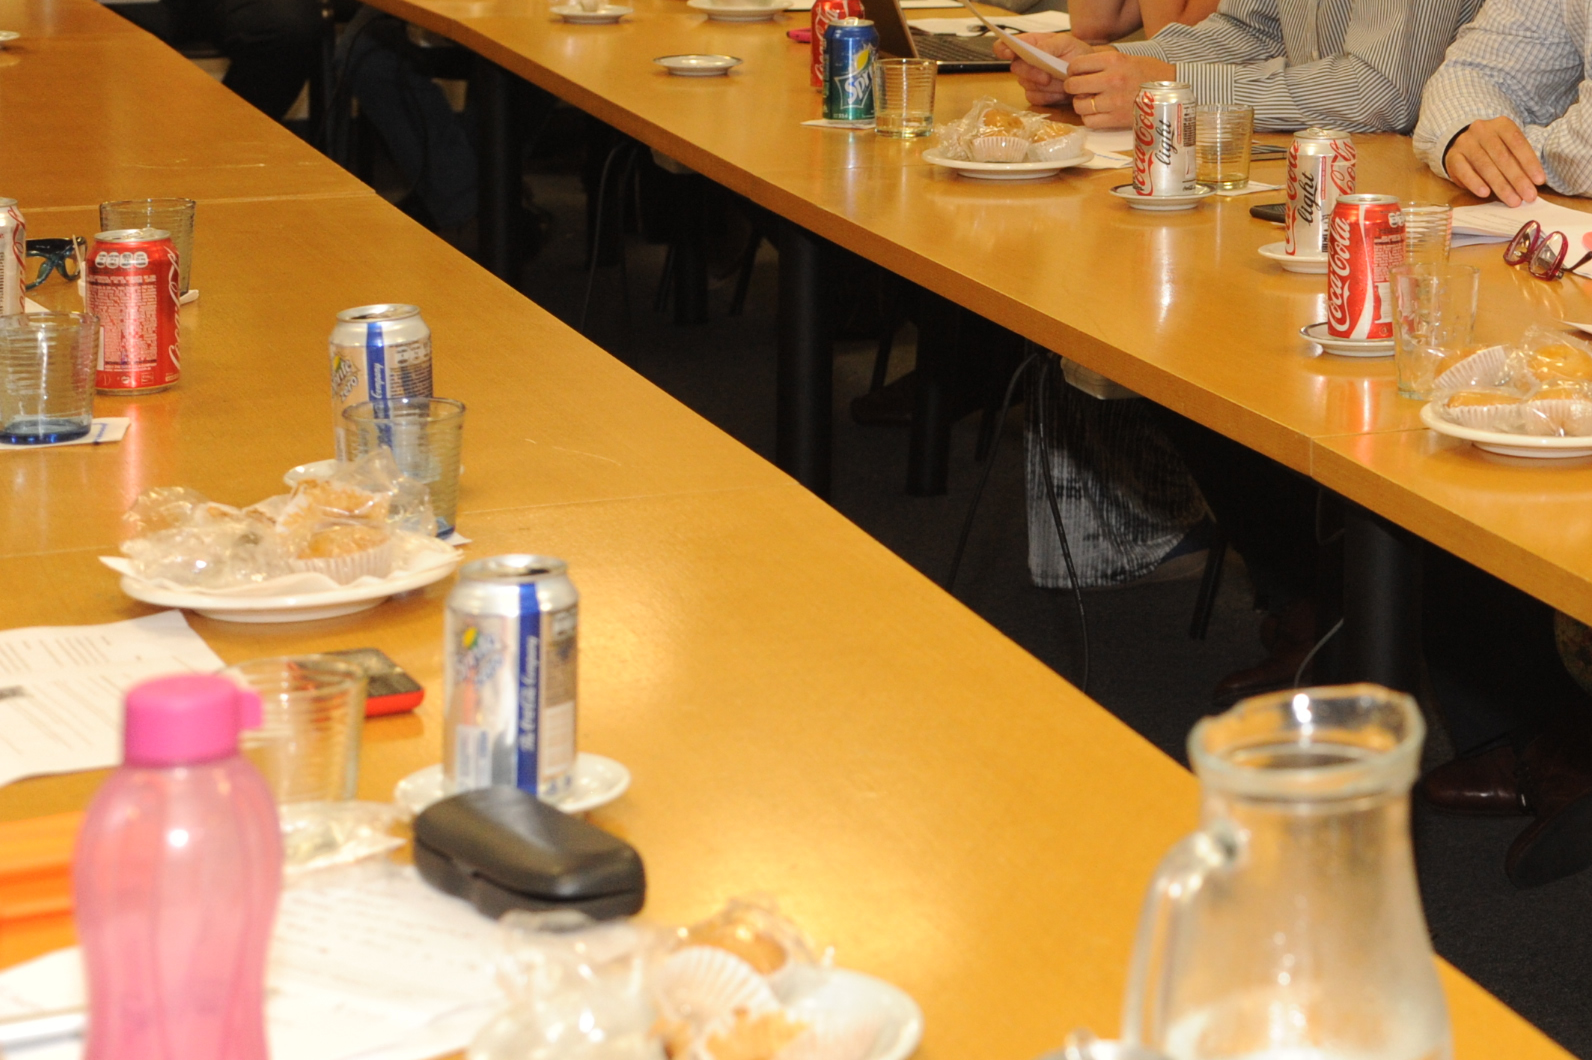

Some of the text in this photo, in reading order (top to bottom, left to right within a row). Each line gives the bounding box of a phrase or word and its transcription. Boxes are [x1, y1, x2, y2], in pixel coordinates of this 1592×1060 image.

[844, 68, 873, 105] Spr
[1133, 90, 1155, 196] CocaCola
[1155, 119, 1178, 166] light
[1297, 171, 1321, 226] light
